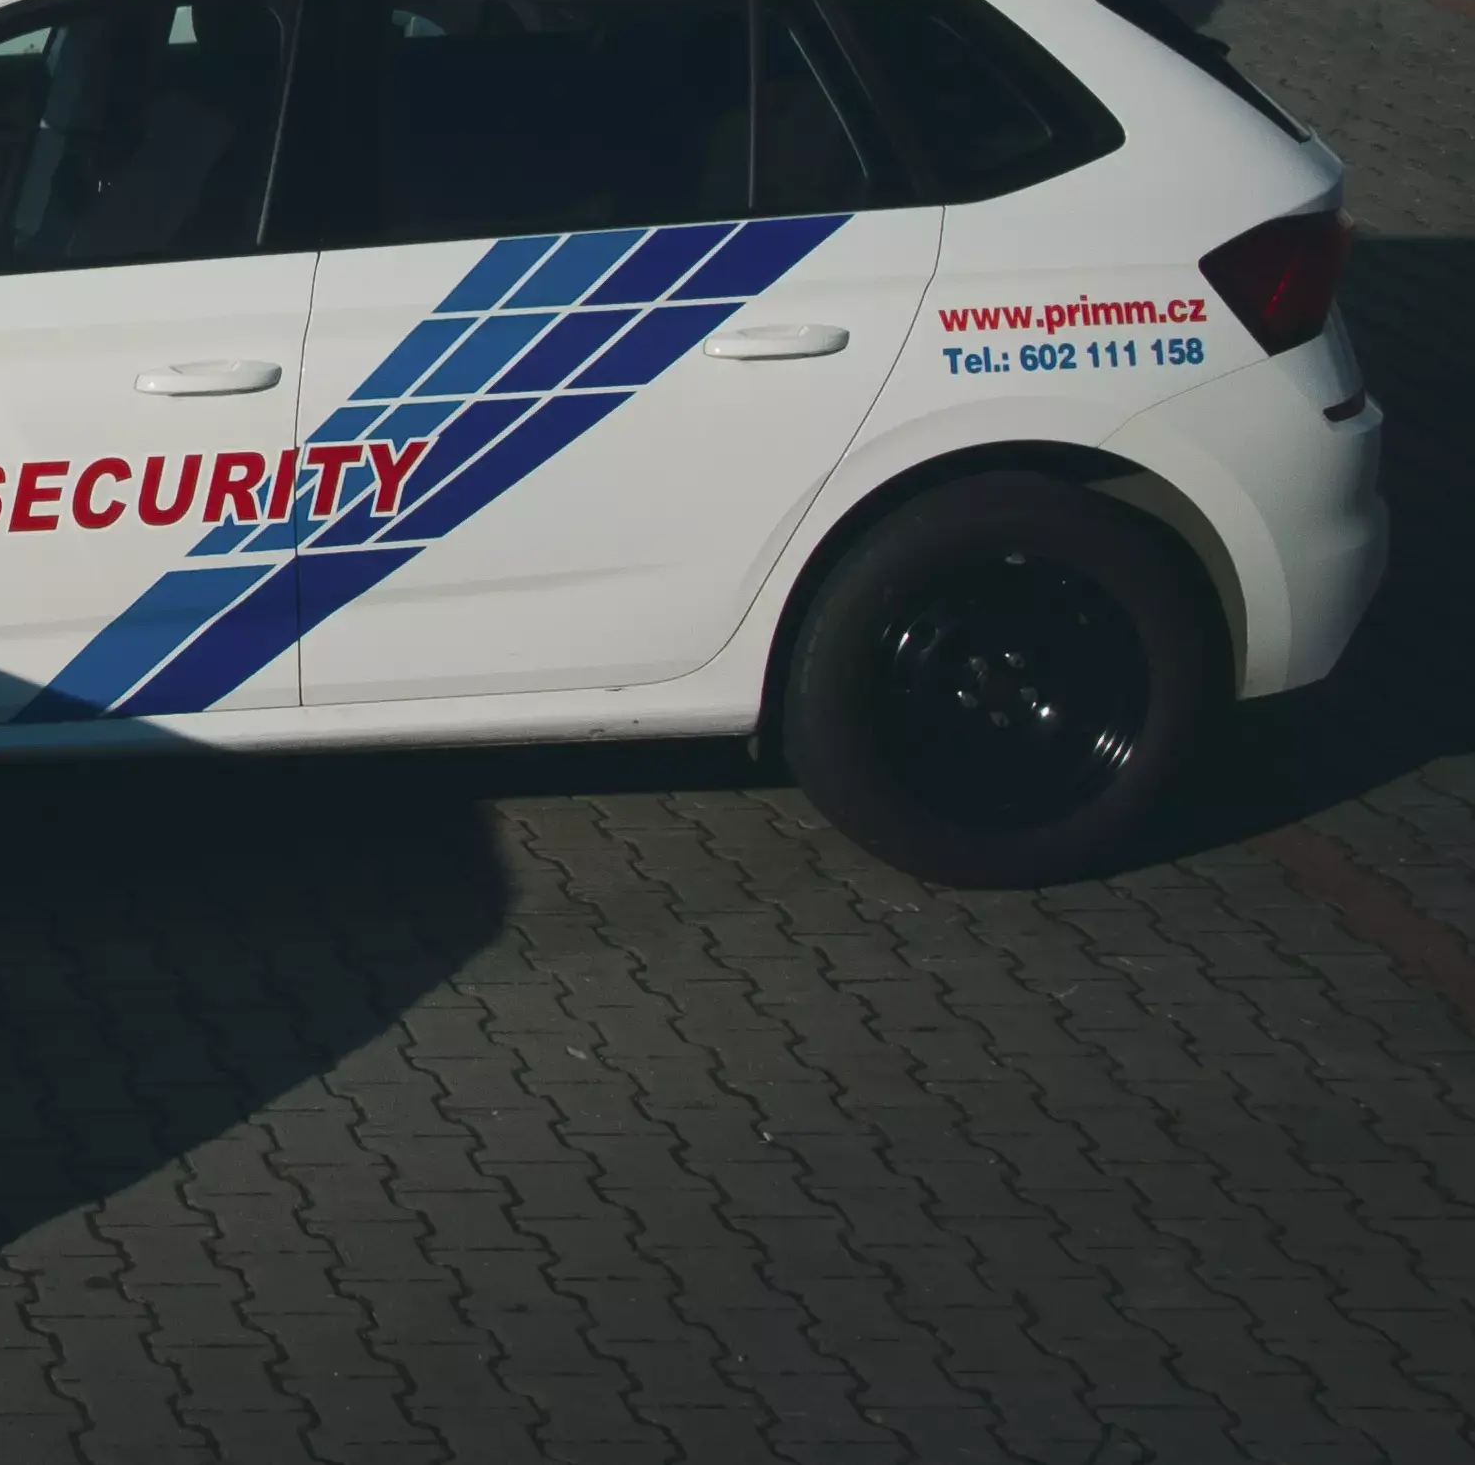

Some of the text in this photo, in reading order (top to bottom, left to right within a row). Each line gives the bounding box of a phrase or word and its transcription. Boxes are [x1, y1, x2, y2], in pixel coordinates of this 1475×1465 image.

[938, 294, 1207, 335] www.primm.cz
[942, 337, 1205, 375] Tel.: 602 111 158
